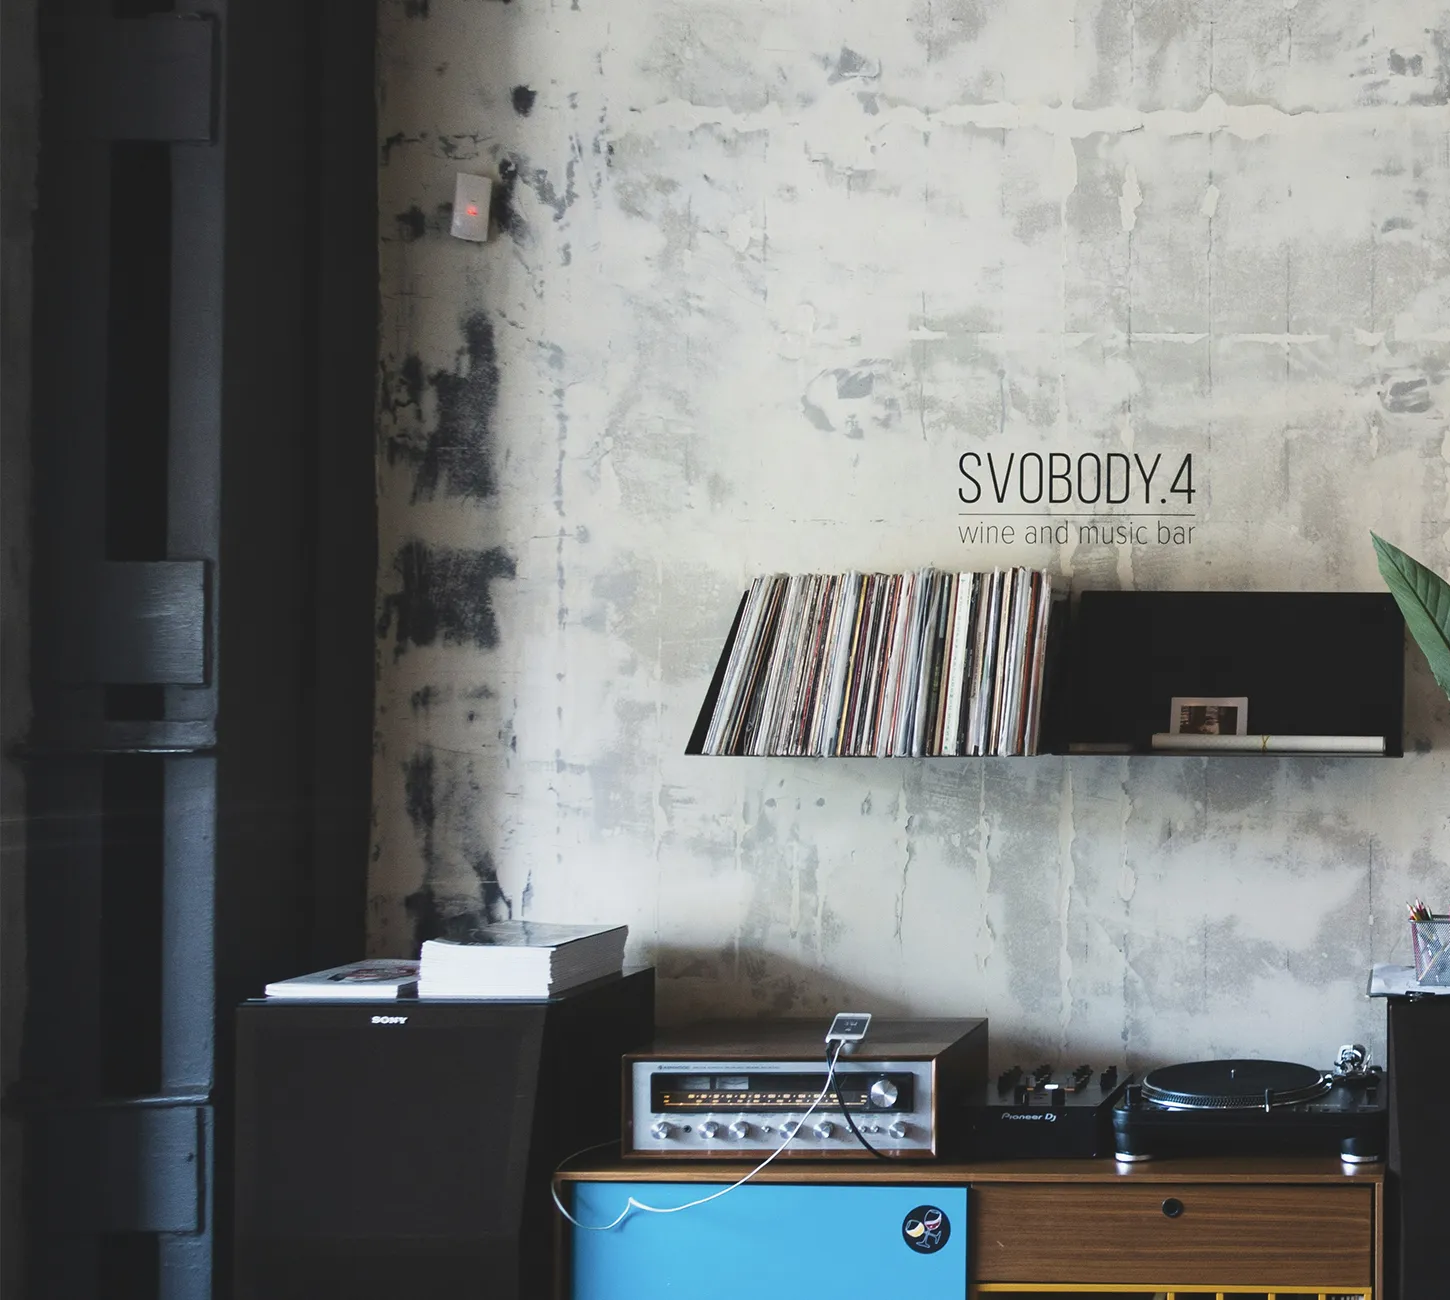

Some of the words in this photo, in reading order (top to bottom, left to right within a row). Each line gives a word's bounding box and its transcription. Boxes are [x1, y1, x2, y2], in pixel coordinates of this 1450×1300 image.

[958, 452, 1196, 504] SVOBODY.4
[958, 521, 1015, 545] wine
[1024, 521, 1069, 545] and
[1079, 521, 1148, 545] music
[1157, 521, 1196, 545] bar
[371, 1015, 408, 1024] SONY
[1001, 1112, 1043, 1120] Pioneer
